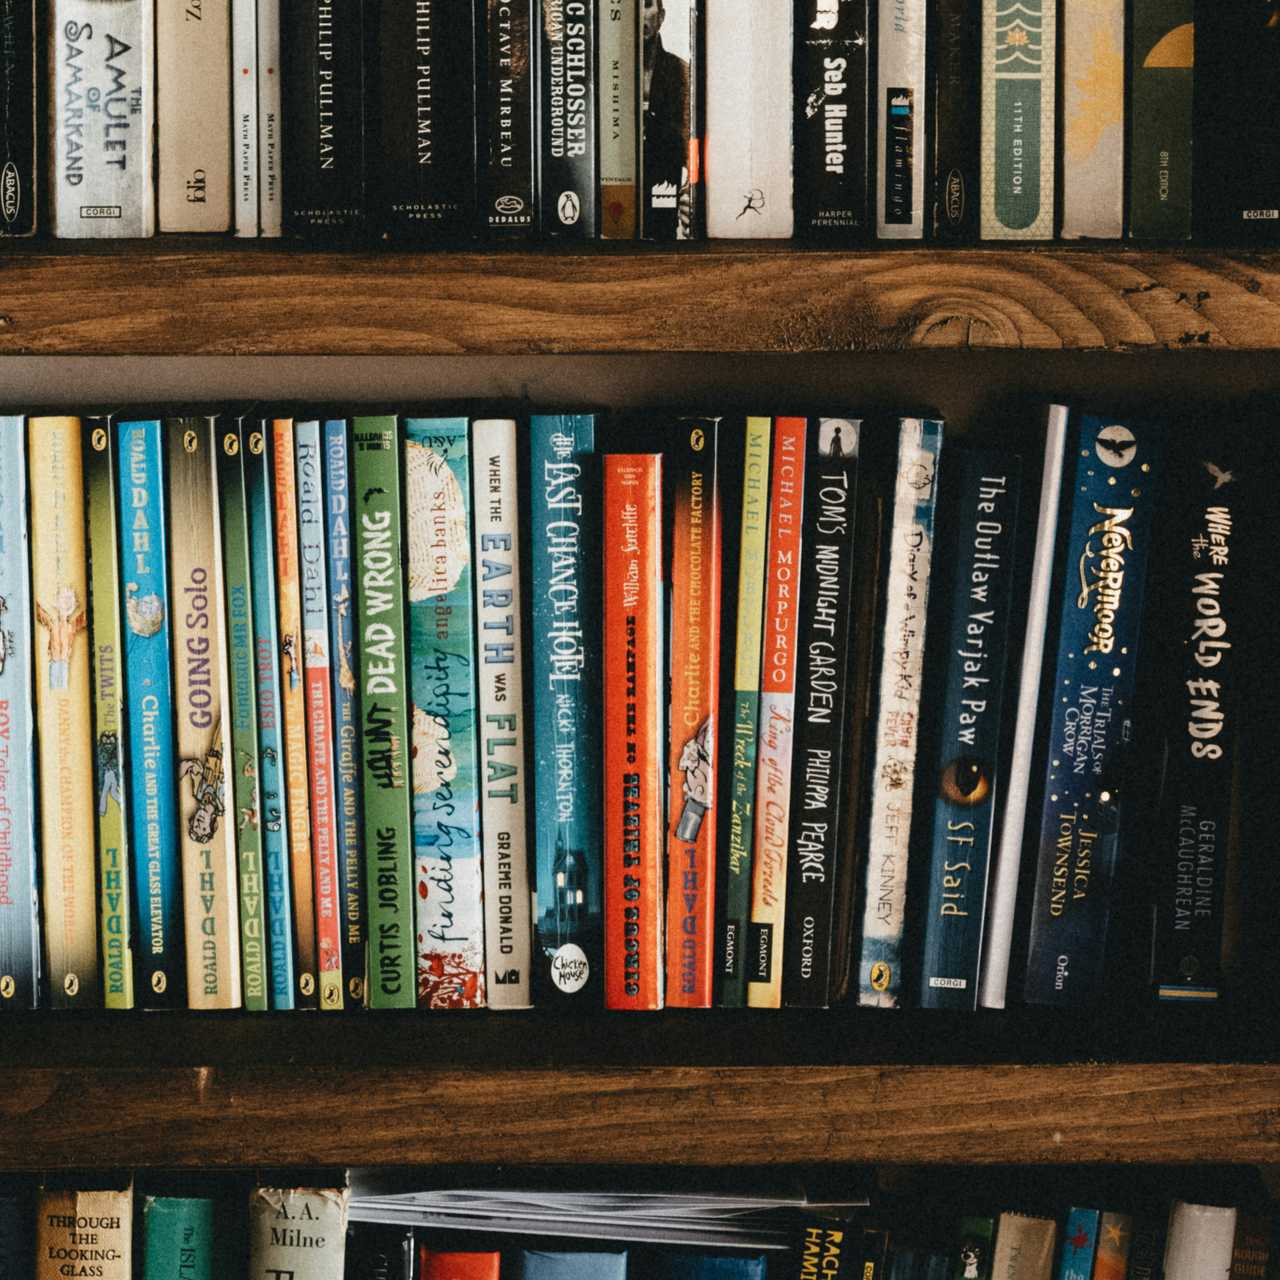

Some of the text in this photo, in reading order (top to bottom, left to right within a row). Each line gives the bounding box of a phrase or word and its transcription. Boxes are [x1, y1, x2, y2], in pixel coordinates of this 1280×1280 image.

[566, 23, 585, 157] SCHLOSSER
[824, 58, 847, 173] Seb Hunter
[1013, 101, 1023, 194] 11TH EDITION
[772, 437, 795, 683] MICHAEL MORPURGO
[481, 456, 518, 803] WHEN THE EARTH WAS FLAT
[497, 832, 513, 954] GRAEME DONALD
[1049, 811, 1075, 916] TOWNSEND
[1072, 830, 1098, 900] JESSICA
[377, 827, 401, 995] CURTIS JOBLING
[801, 917, 814, 978] OXFORD
[48, 1215, 121, 1230] THROUGH
[48, 1248, 121, 1263] LOOKING-
[70, 1232, 97, 1245] THE
[270, 1229, 325, 1247] Milne
[61, 1264, 103, 1278] GLASS
